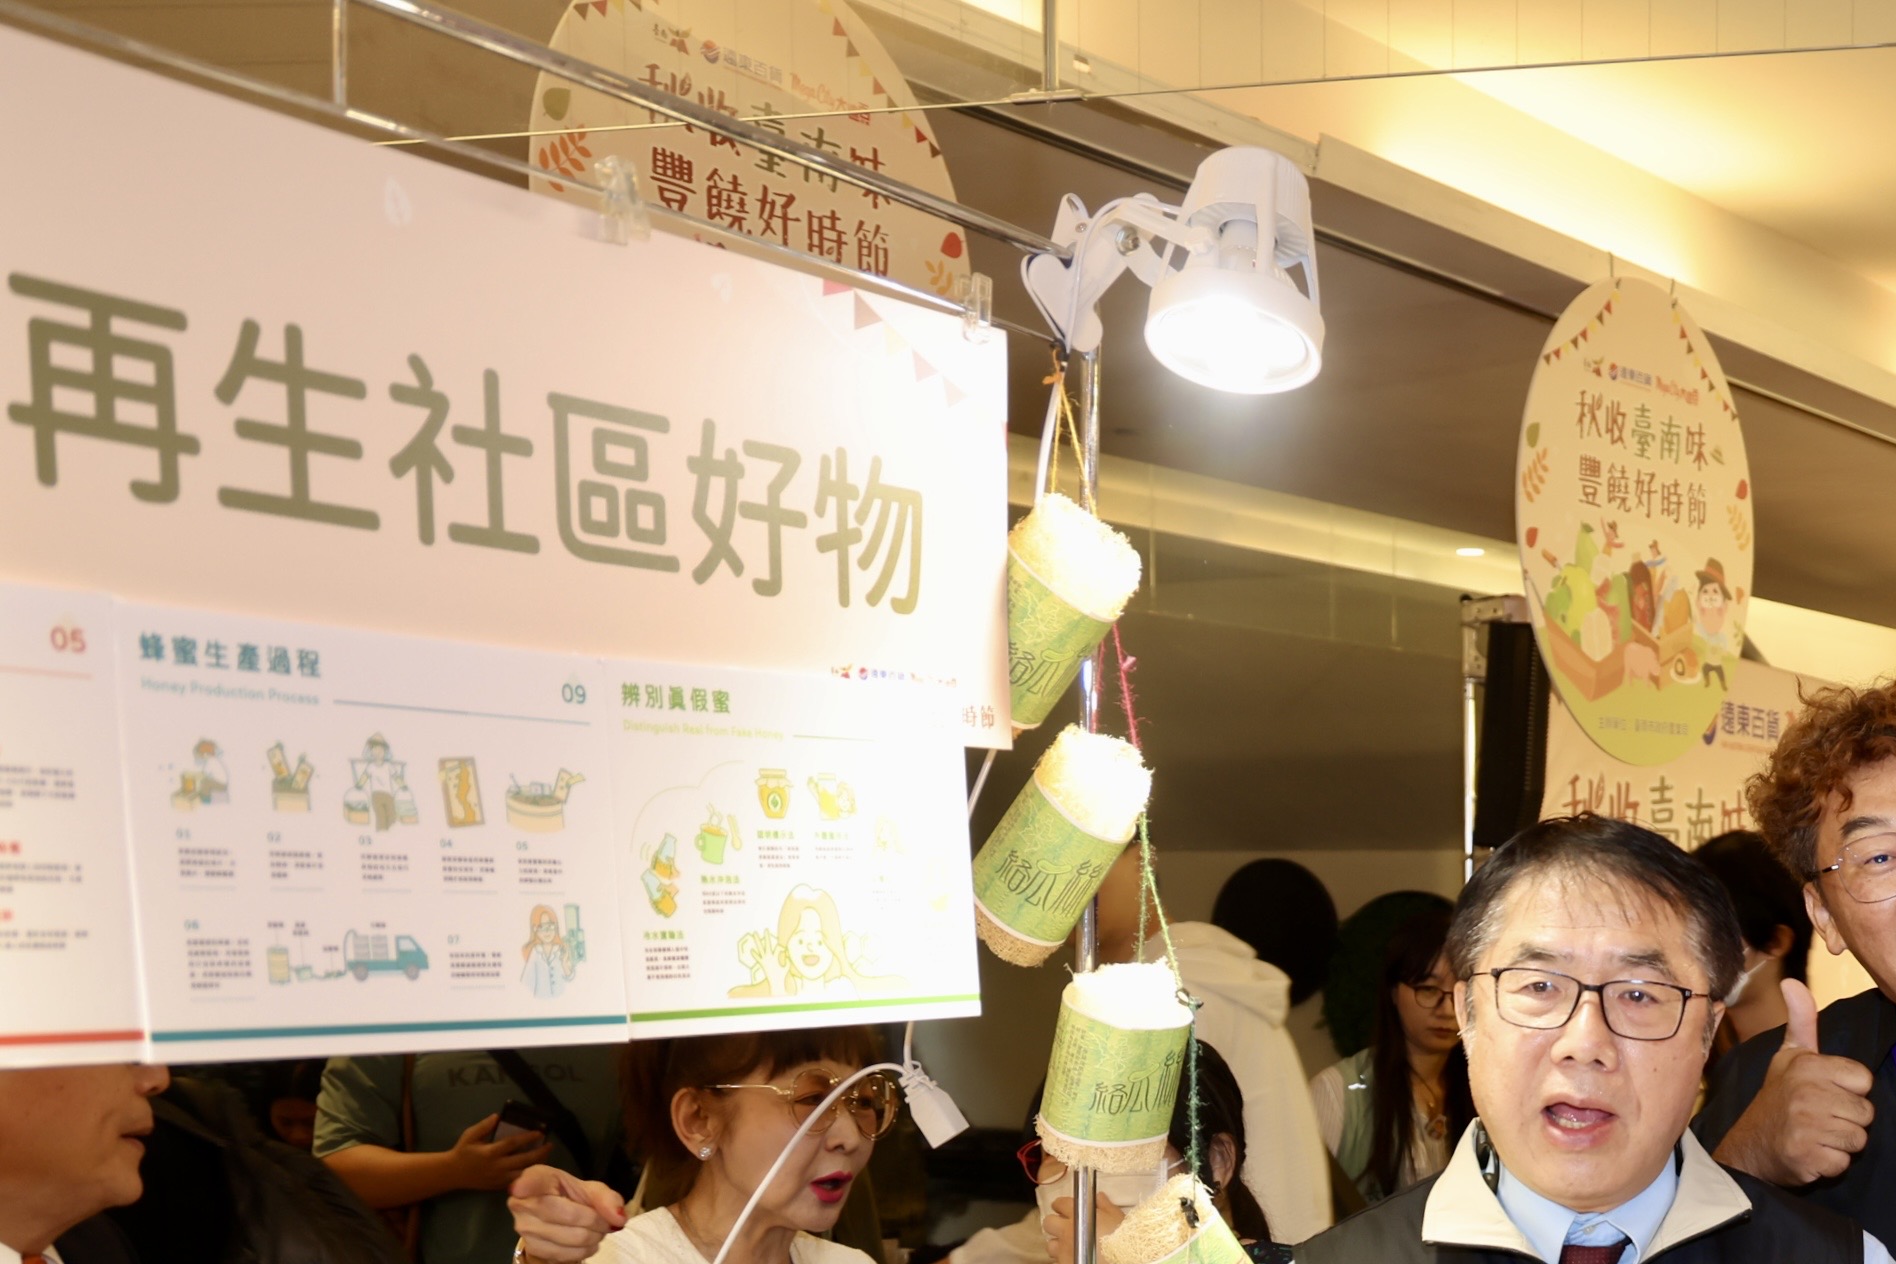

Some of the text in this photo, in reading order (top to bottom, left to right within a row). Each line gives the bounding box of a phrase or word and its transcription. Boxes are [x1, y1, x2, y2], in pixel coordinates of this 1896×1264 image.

[6, 272, 924, 614] 再生社區好物
[1576, 390, 1709, 472] 秋收臺南味
[1578, 454, 1706, 529] 豐饒好時節
[51, 626, 86, 653] 05
[139, 632, 322, 678] 蜂蜜生產過程
[141, 677, 186, 695] Honey
[190, 682, 265, 701] Production
[561, 683, 587, 705] 09
[447, 1062, 583, 1087] KAOL
